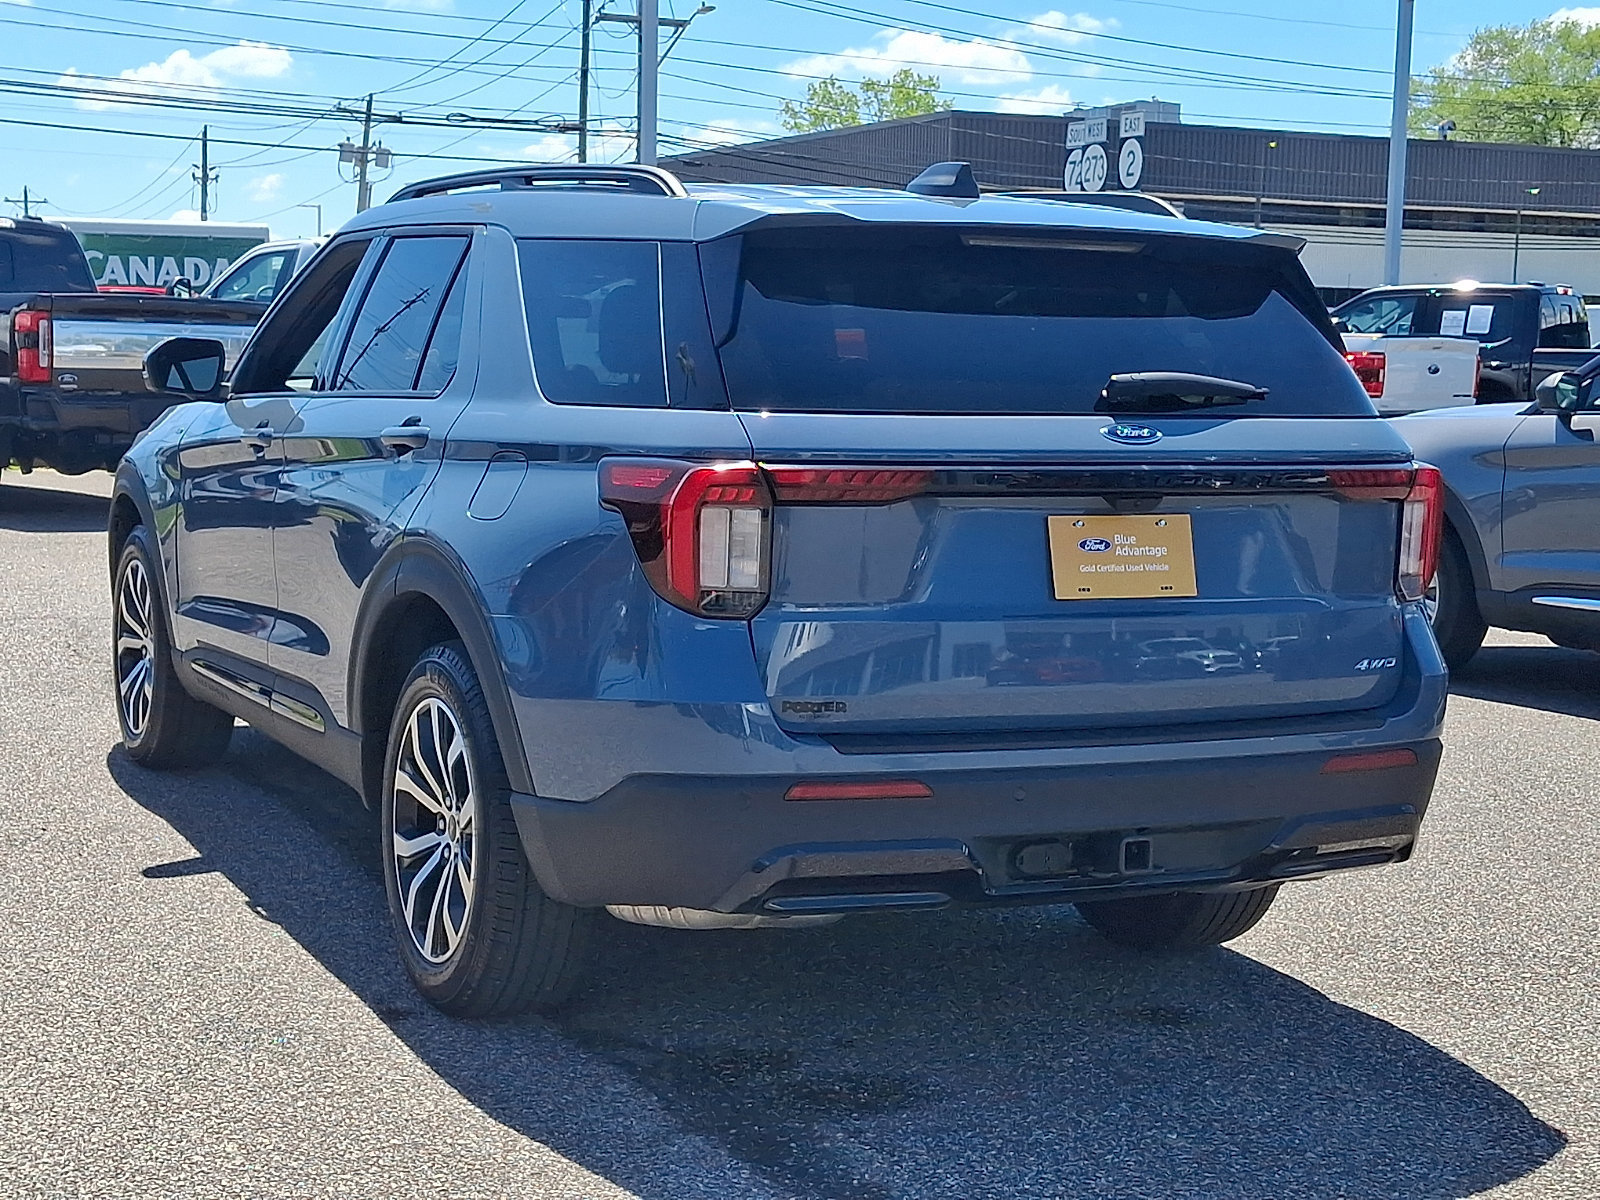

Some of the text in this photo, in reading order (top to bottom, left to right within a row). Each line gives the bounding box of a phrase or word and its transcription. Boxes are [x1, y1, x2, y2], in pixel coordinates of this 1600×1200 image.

[1087, 122, 1104, 138] WEST
[1124, 117, 1141, 133] EAST
[1069, 126, 1085, 143] SOUT
[1083, 154, 1105, 183] 273
[1126, 150, 1136, 177] 2
[85, 250, 231, 287] CANADA
[1116, 425, 1151, 437] Ford
[1084, 539, 1106, 550] Ford
[1114, 534, 1136, 545] Blue
[1115, 546, 1168, 557] Advantage
[1079, 562, 1169, 573] Gold Certified Used Vehicle
[1354, 657, 1397, 670] 4WD
[781, 700, 847, 713] PORTER
